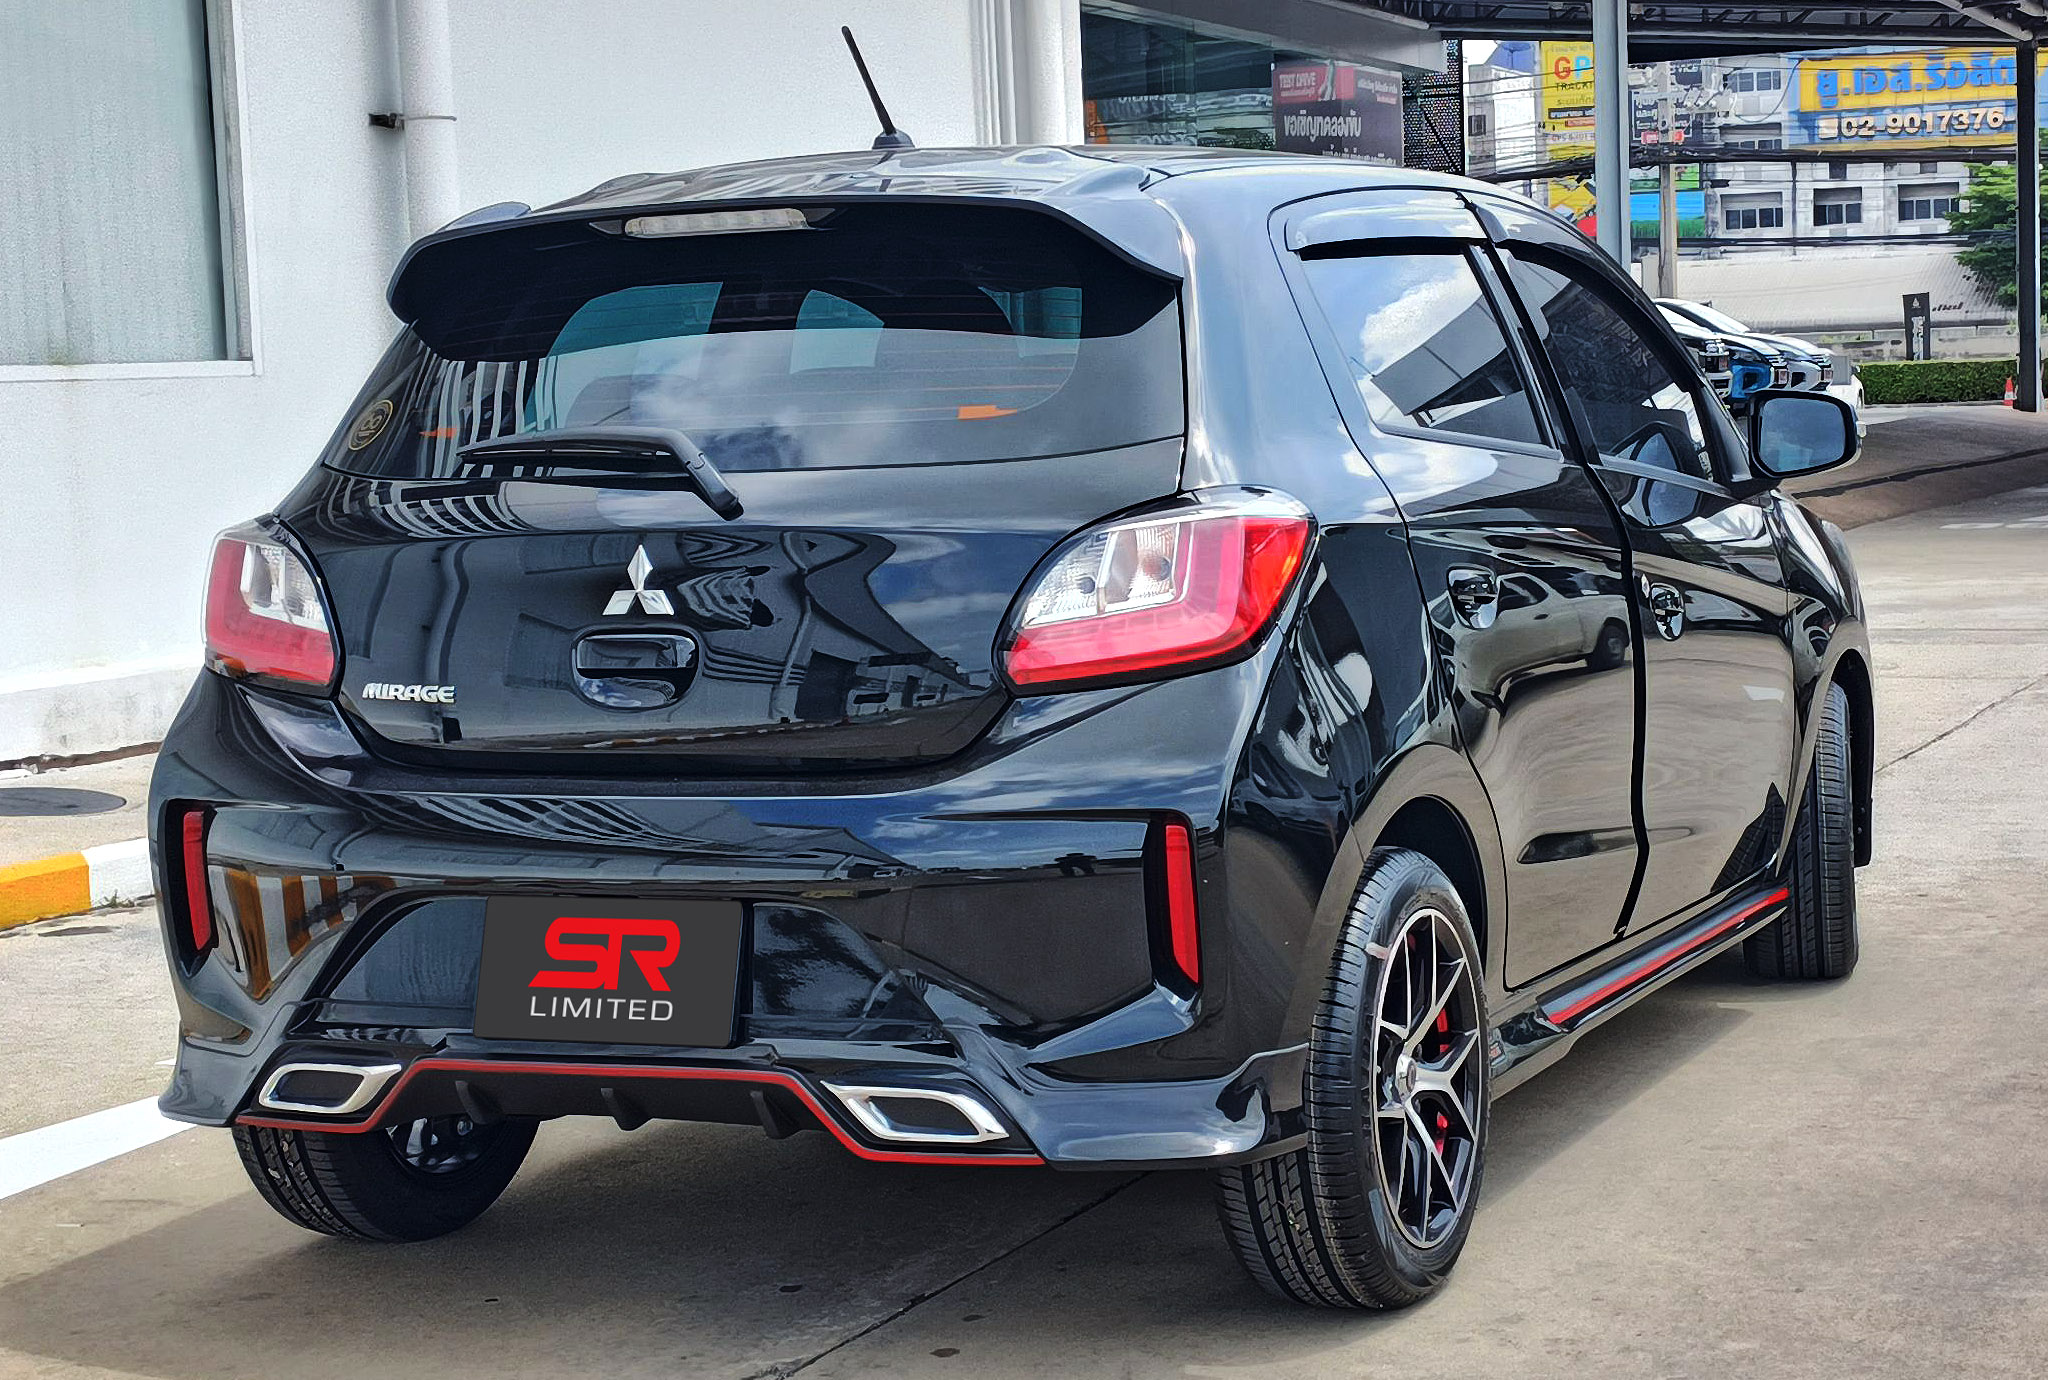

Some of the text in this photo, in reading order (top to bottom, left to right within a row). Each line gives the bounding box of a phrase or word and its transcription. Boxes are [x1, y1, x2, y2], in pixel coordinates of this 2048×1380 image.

[1554, 55, 1593, 80] GP
[362, 683, 455, 703] MIRAGE
[530, 996, 673, 1021] LIMITED
